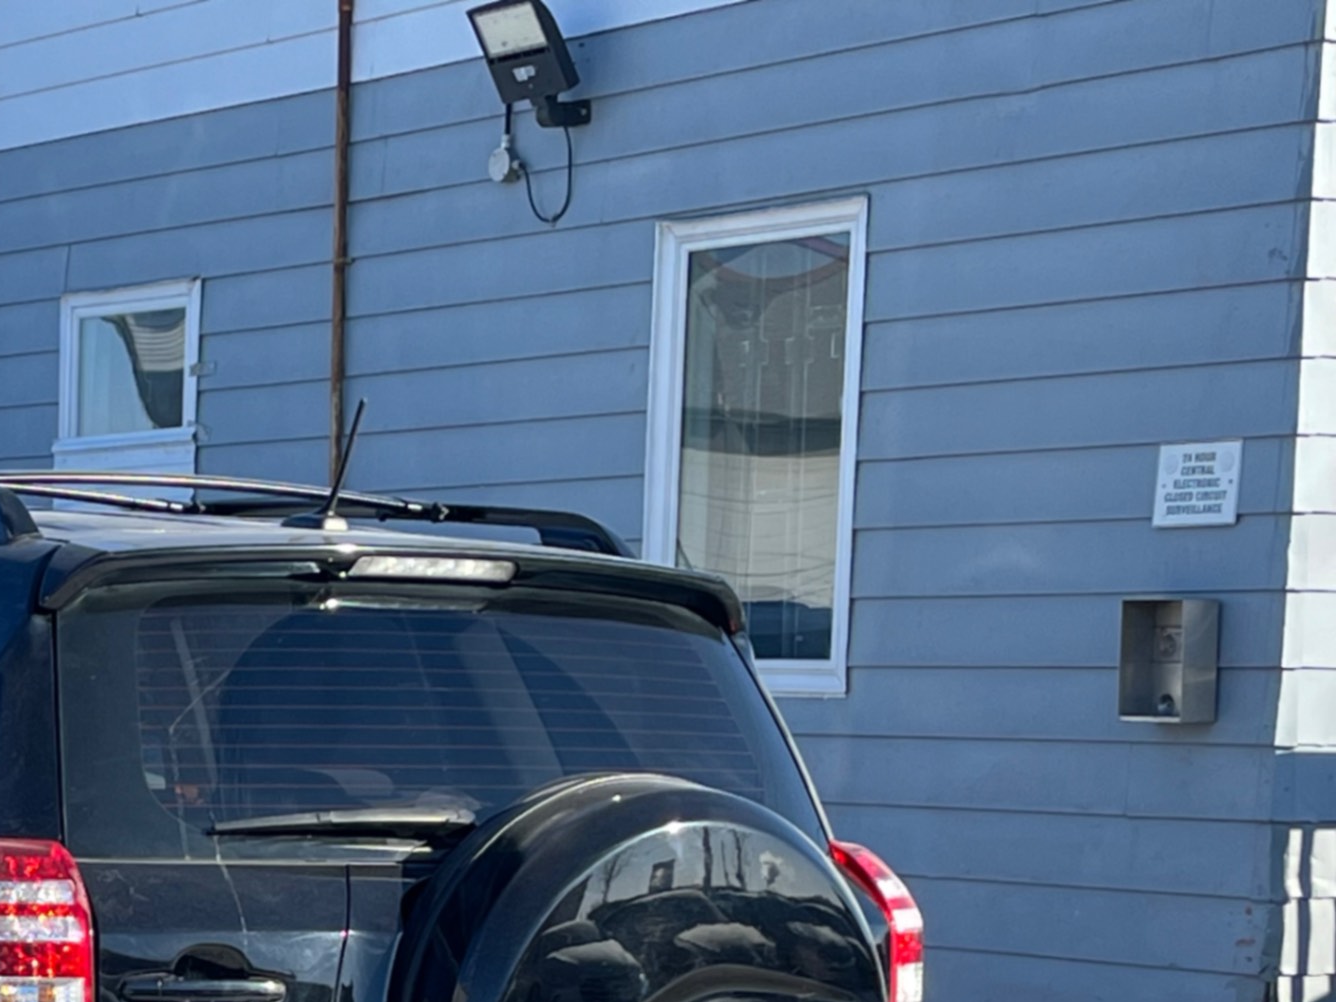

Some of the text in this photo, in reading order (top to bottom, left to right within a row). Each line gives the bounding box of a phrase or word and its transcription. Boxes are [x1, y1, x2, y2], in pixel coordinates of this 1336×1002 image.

[1180, 465, 1215, 476] CENTRAL
[1173, 478, 1221, 490] ELECTRONIC
[1166, 503, 1223, 515] SURVEILLANCE
